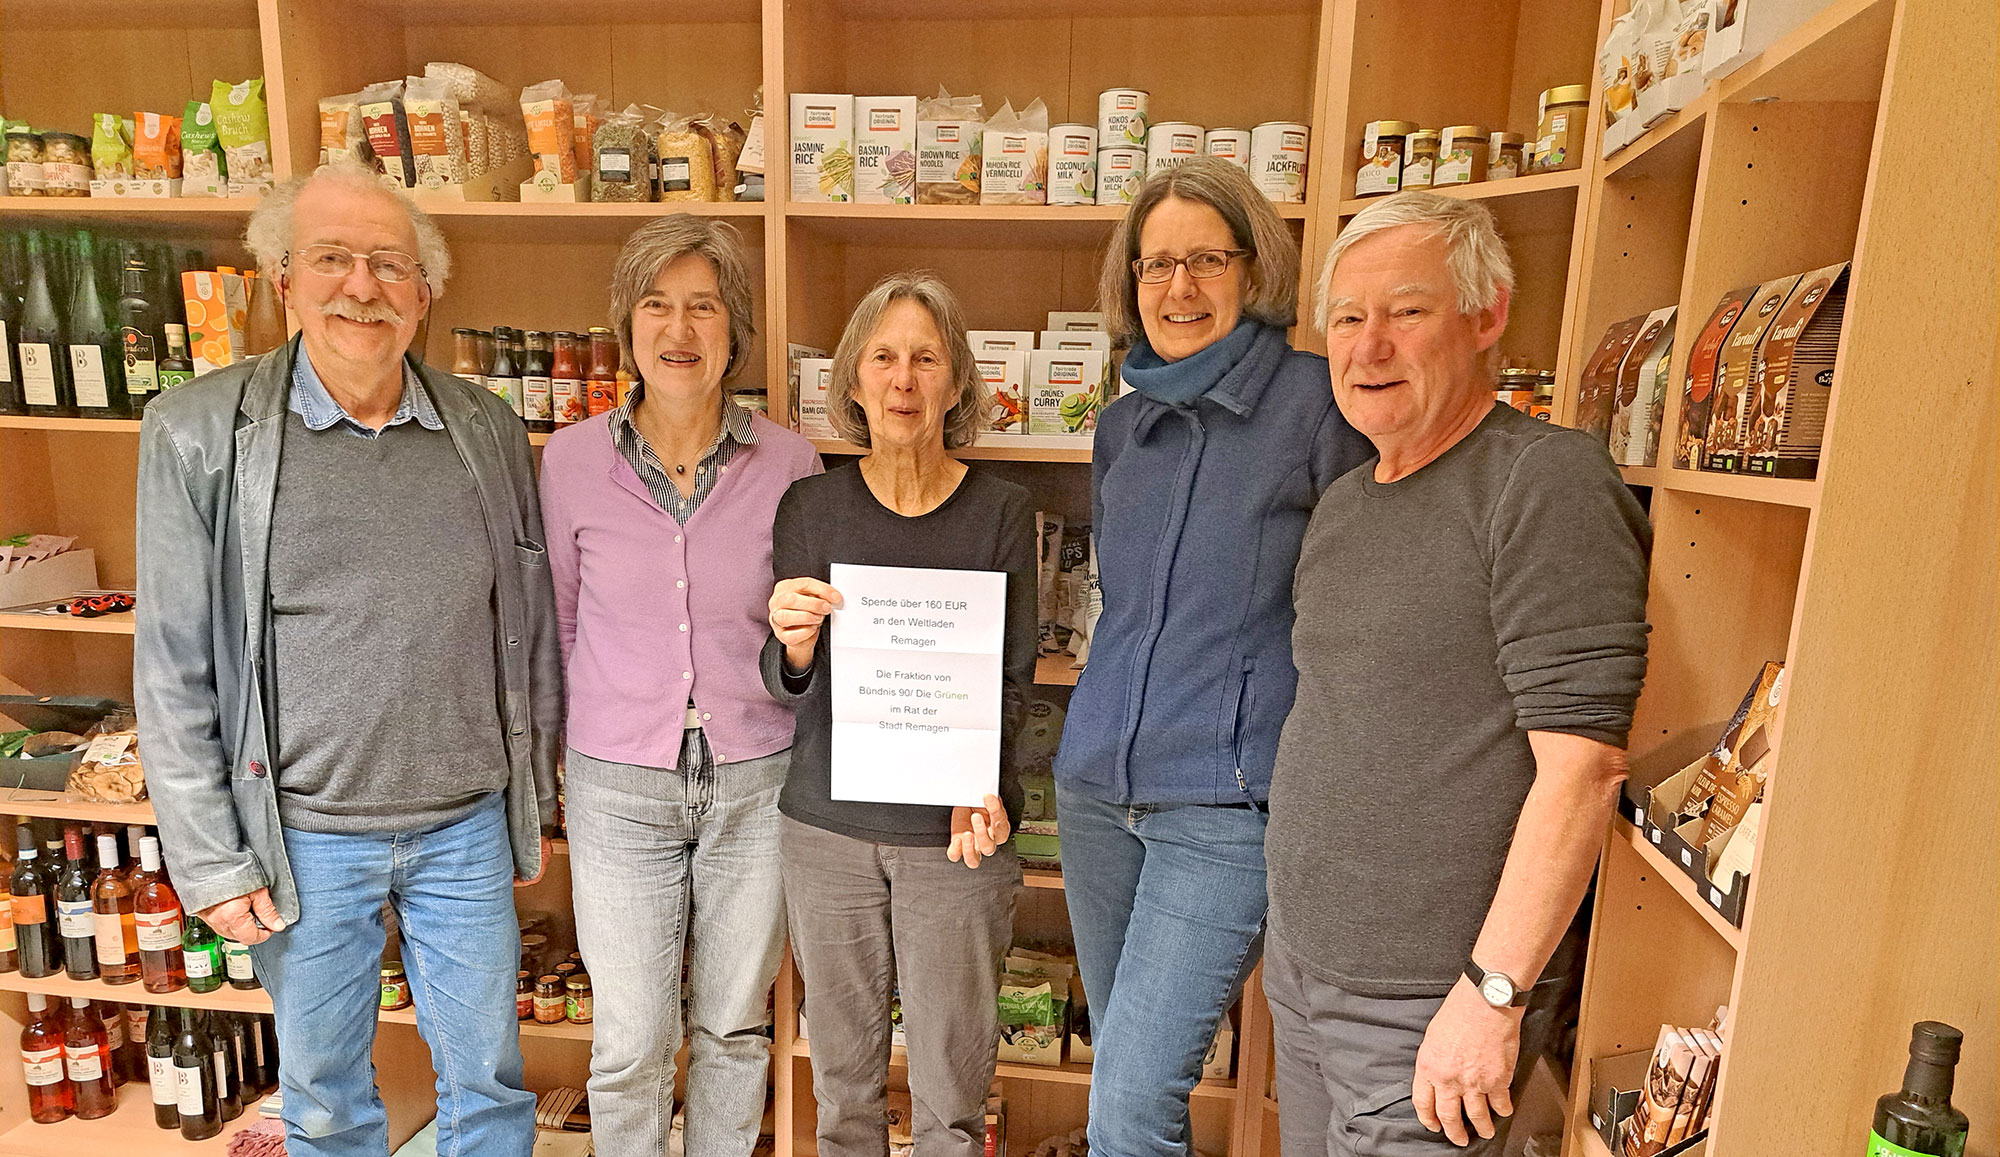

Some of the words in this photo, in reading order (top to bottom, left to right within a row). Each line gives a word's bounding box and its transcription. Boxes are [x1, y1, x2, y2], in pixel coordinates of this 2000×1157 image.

[217, 113, 250, 125] Cashew
[222, 123, 248, 135] Bruch
[181, 131, 216, 140] Cashews
[794, 142, 825, 153] JASMINE
[858, 145, 891, 156] BASMATI
[795, 153, 815, 165] RICE
[920, 150, 944, 160] BROWN
[945, 151, 960, 160] RICE
[859, 156, 879, 168] RICE
[920, 160, 944, 168] NOODLES
[1008, 161, 1022, 169] RICE
[1056, 162, 1086, 171] COCONUT
[985, 170, 1023, 178] VERMICELLI
[1057, 171, 1074, 179] MILK
[1103, 175, 1123, 183] KOKOS
[1104, 183, 1122, 191] MILCH
[24, 346, 37, 366] B
[75, 349, 88, 368] B
[1040, 388, 1065, 397] GRÜNES
[1033, 398, 1061, 407] CURRY
[802, 406, 815, 415] BAMI
[861, 596, 898, 607] Spende
[900, 599, 922, 609] über
[925, 600, 942, 609] 160
[944, 601, 968, 611] EUR
[873, 617, 885, 625] an
[887, 617, 906, 626] den
[908, 617, 955, 629] Weltladen
[891, 635, 937, 648] Remagen
[876, 669, 892, 679] Die
[894, 670, 932, 681] Fraktion
[934, 674, 952, 682] von
[859, 686, 897, 697] Bündnis
[898, 688, 914, 697] 90/
[916, 689, 932, 699] Die
[934, 690, 969, 700] Grünen
[890, 705, 902, 714] im
[903, 705, 920, 715] Rat
[922, 706, 938, 716] der
[879, 720, 903, 731] Stadt
[905, 722, 950, 735] Remagen
[1716, 791, 1740, 815] ESPRESSO
[1711, 803, 1734, 826] CARAMEL
